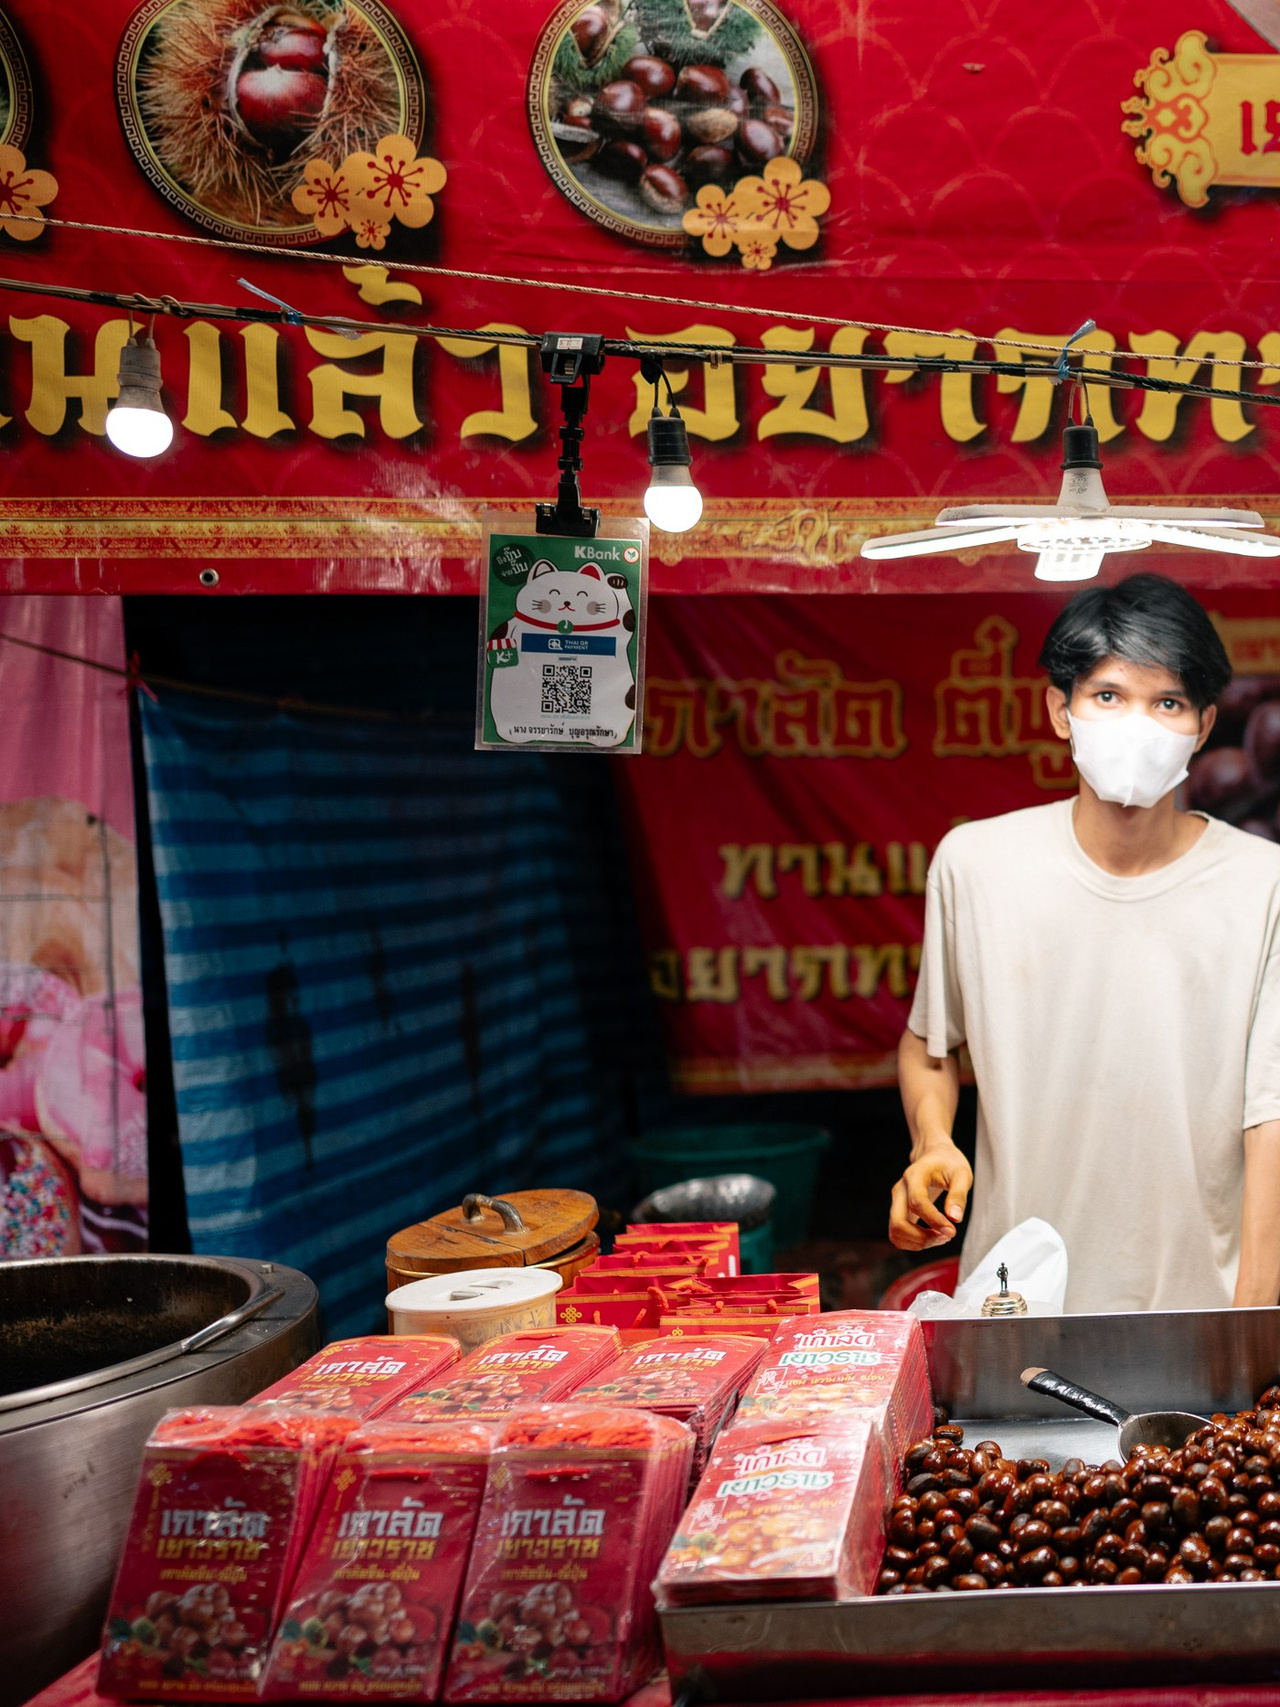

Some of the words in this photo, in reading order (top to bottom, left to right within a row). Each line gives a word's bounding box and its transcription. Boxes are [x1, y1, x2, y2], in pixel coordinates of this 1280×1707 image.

[0, 264, 541, 443] นแล้ว
[574, 545, 621, 562] KBank
[644, 648, 908, 760] กาลัด
[719, 841, 927, 899] ทานแ
[652, 944, 920, 1002] อยากท
[719, 1472, 833, 1496] เยาวราช
[337, 1496, 444, 1538] เกาลัด
[500, 1494, 606, 1537] เกาลัด
